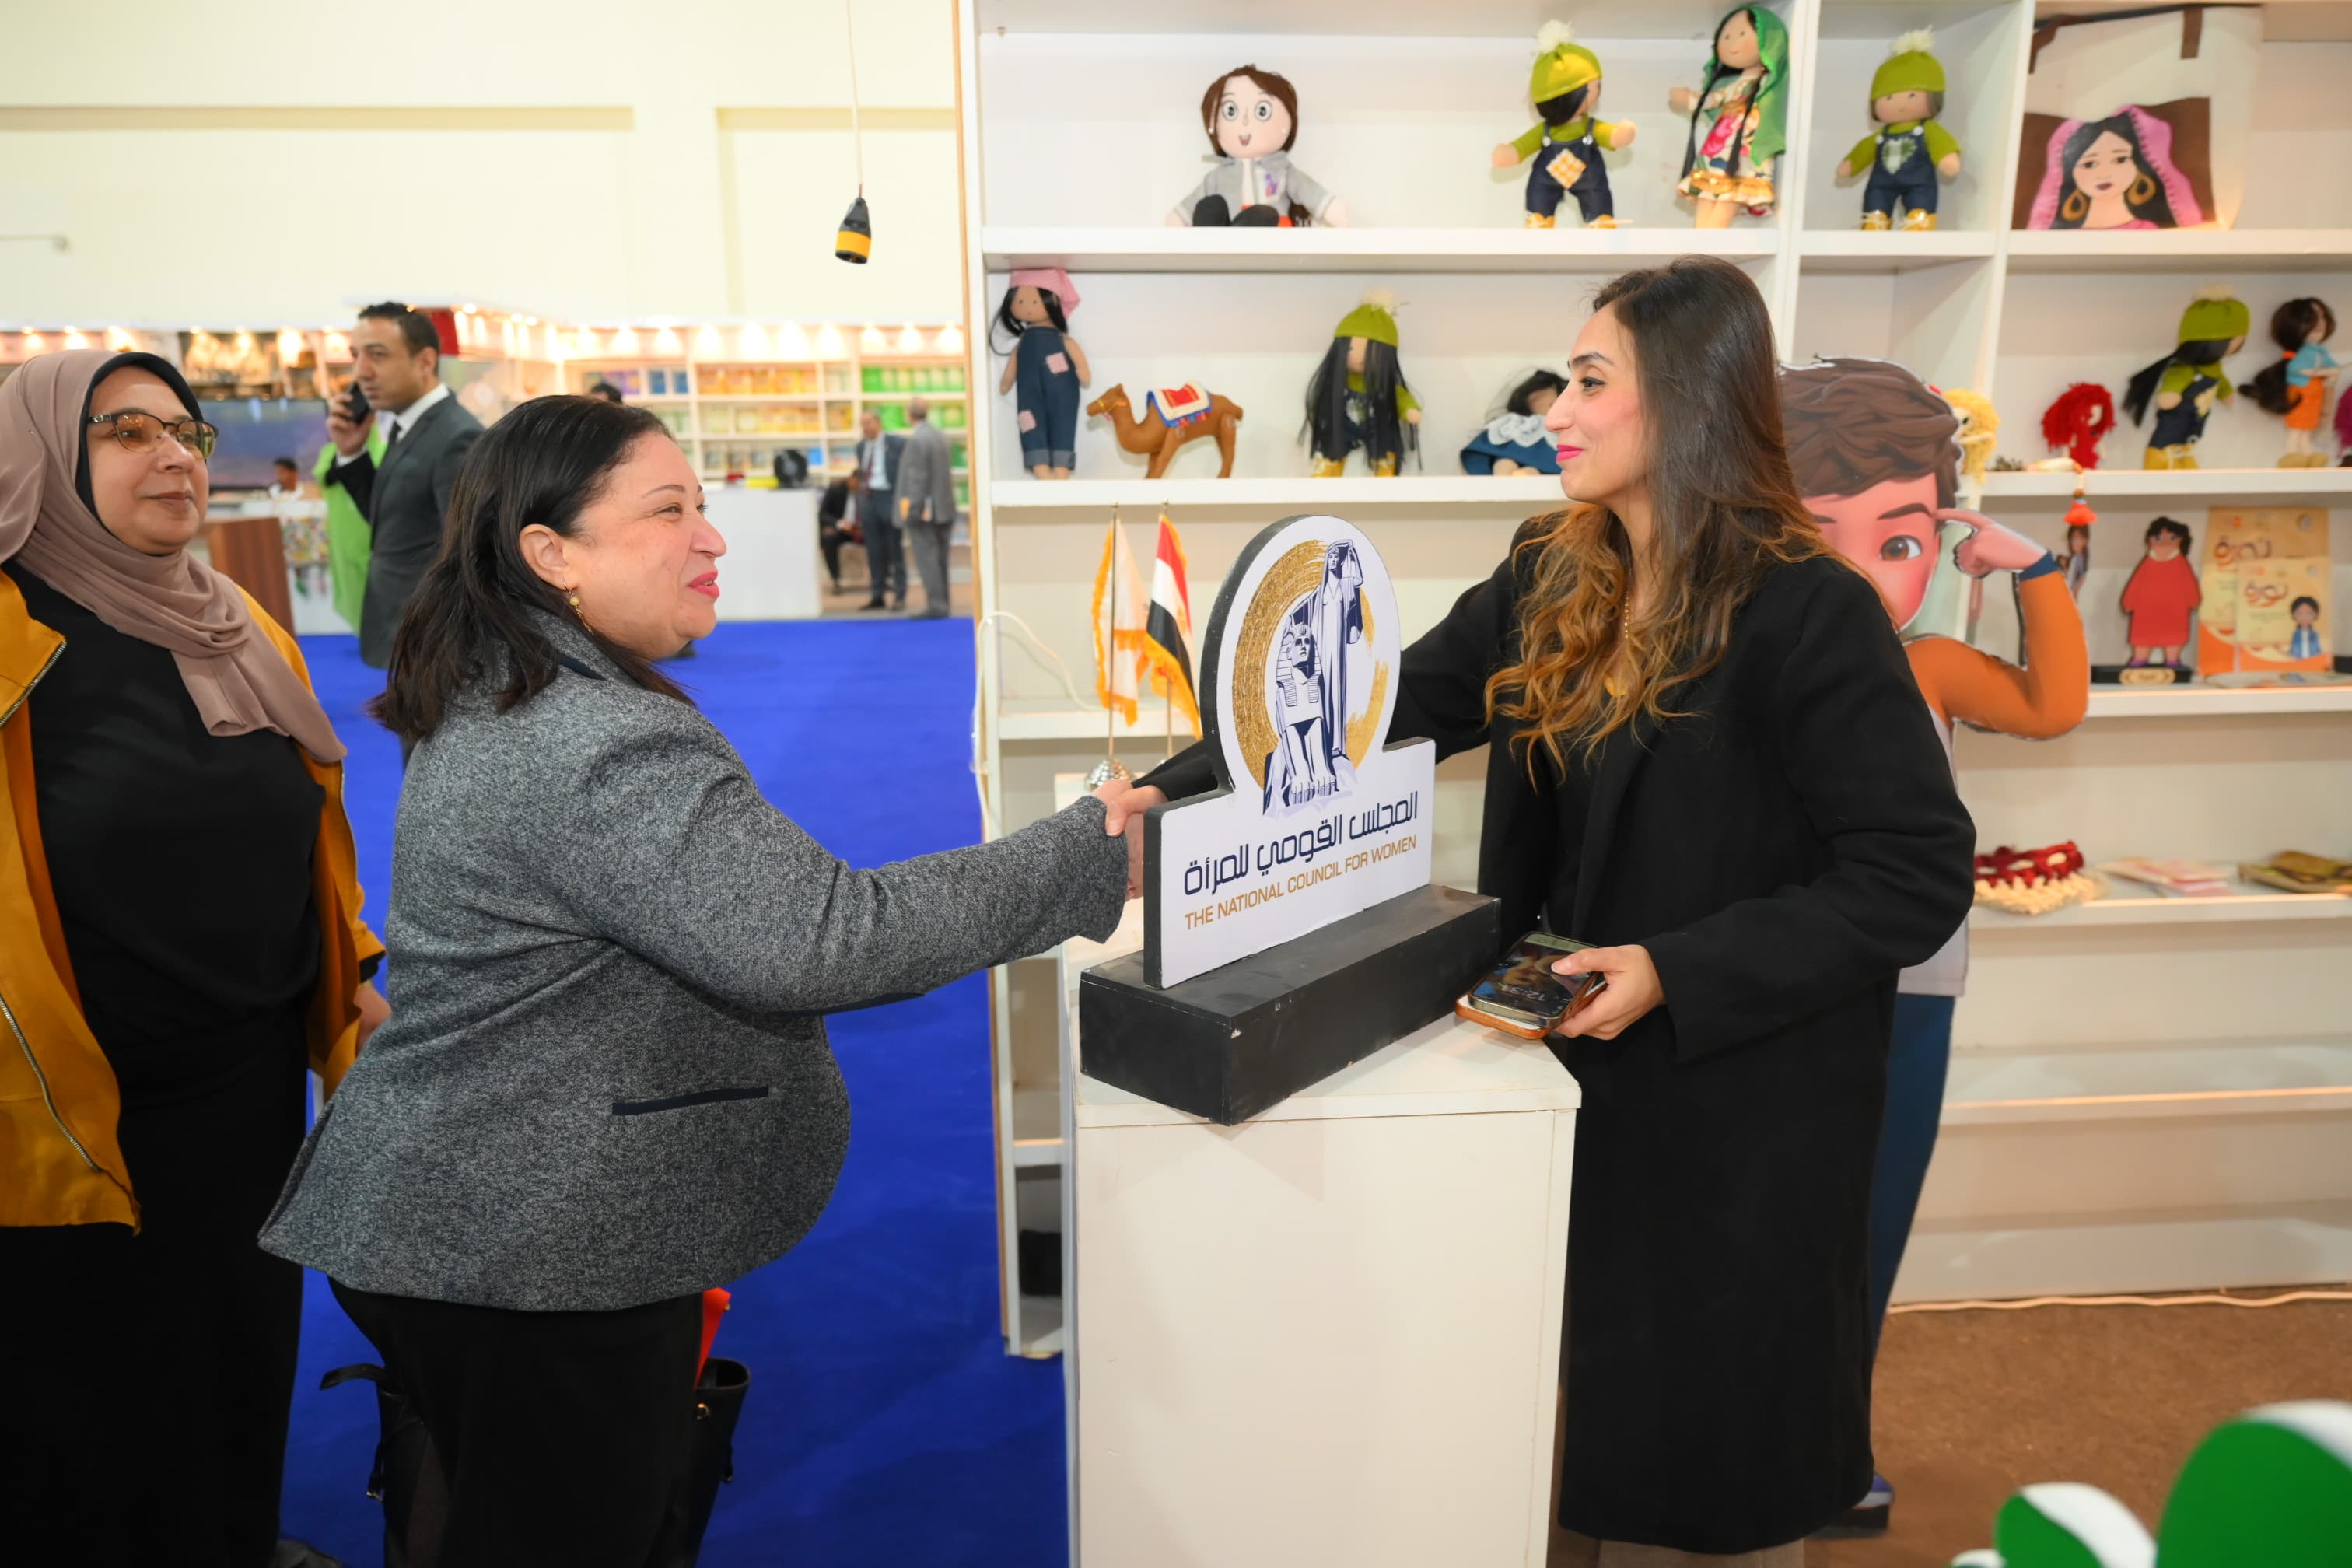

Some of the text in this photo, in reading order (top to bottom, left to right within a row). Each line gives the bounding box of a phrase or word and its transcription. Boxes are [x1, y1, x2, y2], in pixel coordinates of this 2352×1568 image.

[1185, 791, 1418, 895] المجلس القومي للمرأة
[1185, 835, 1416, 930] THE NATIONAL COUNCIL FOR WOMEN
